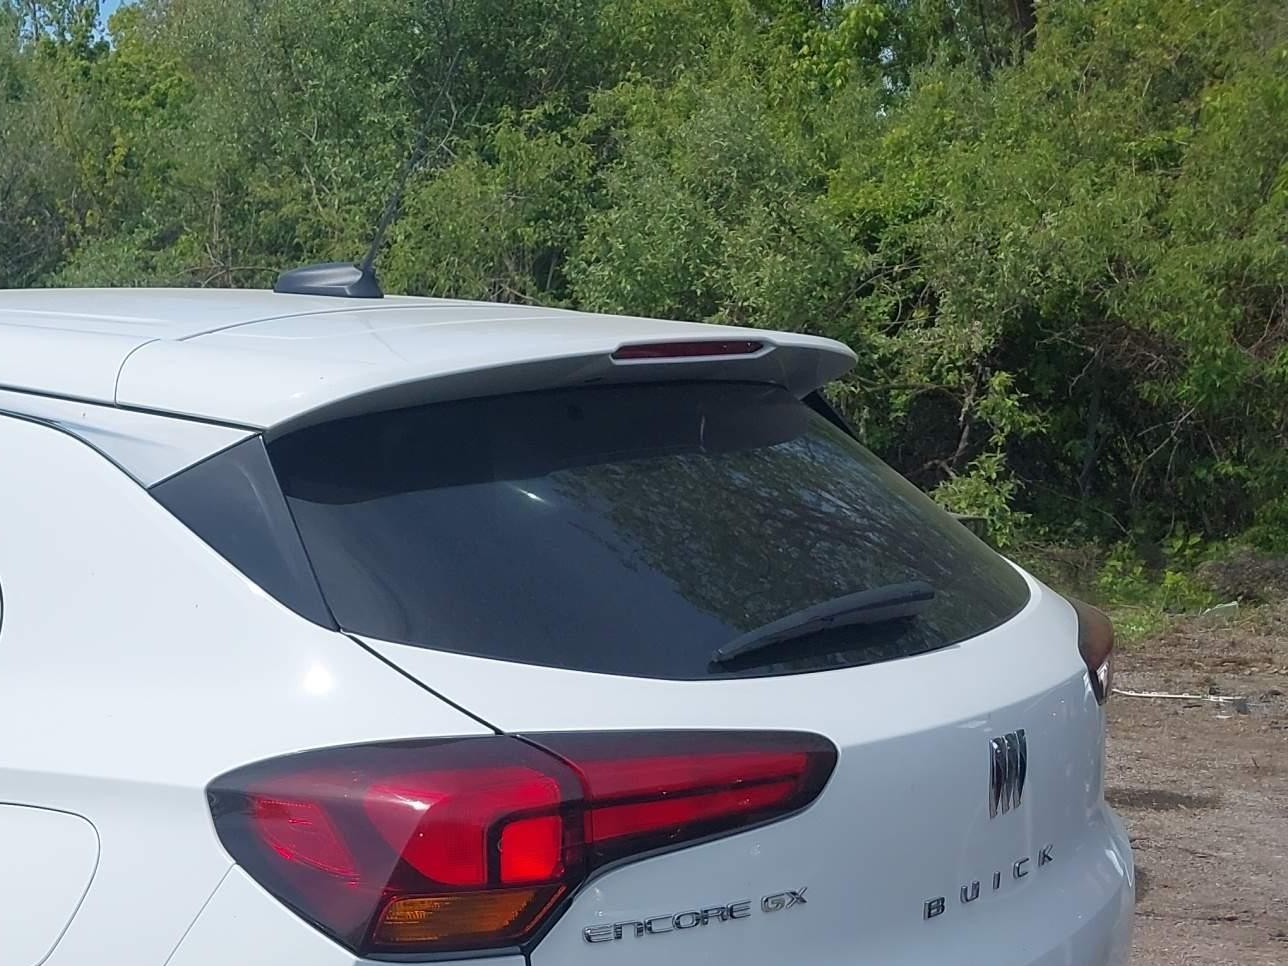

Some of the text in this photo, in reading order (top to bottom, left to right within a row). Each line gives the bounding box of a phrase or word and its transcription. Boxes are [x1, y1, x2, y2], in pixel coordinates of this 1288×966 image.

[582, 886, 809, 945] ENCORE GX
[922, 843, 1054, 921] BUICK
